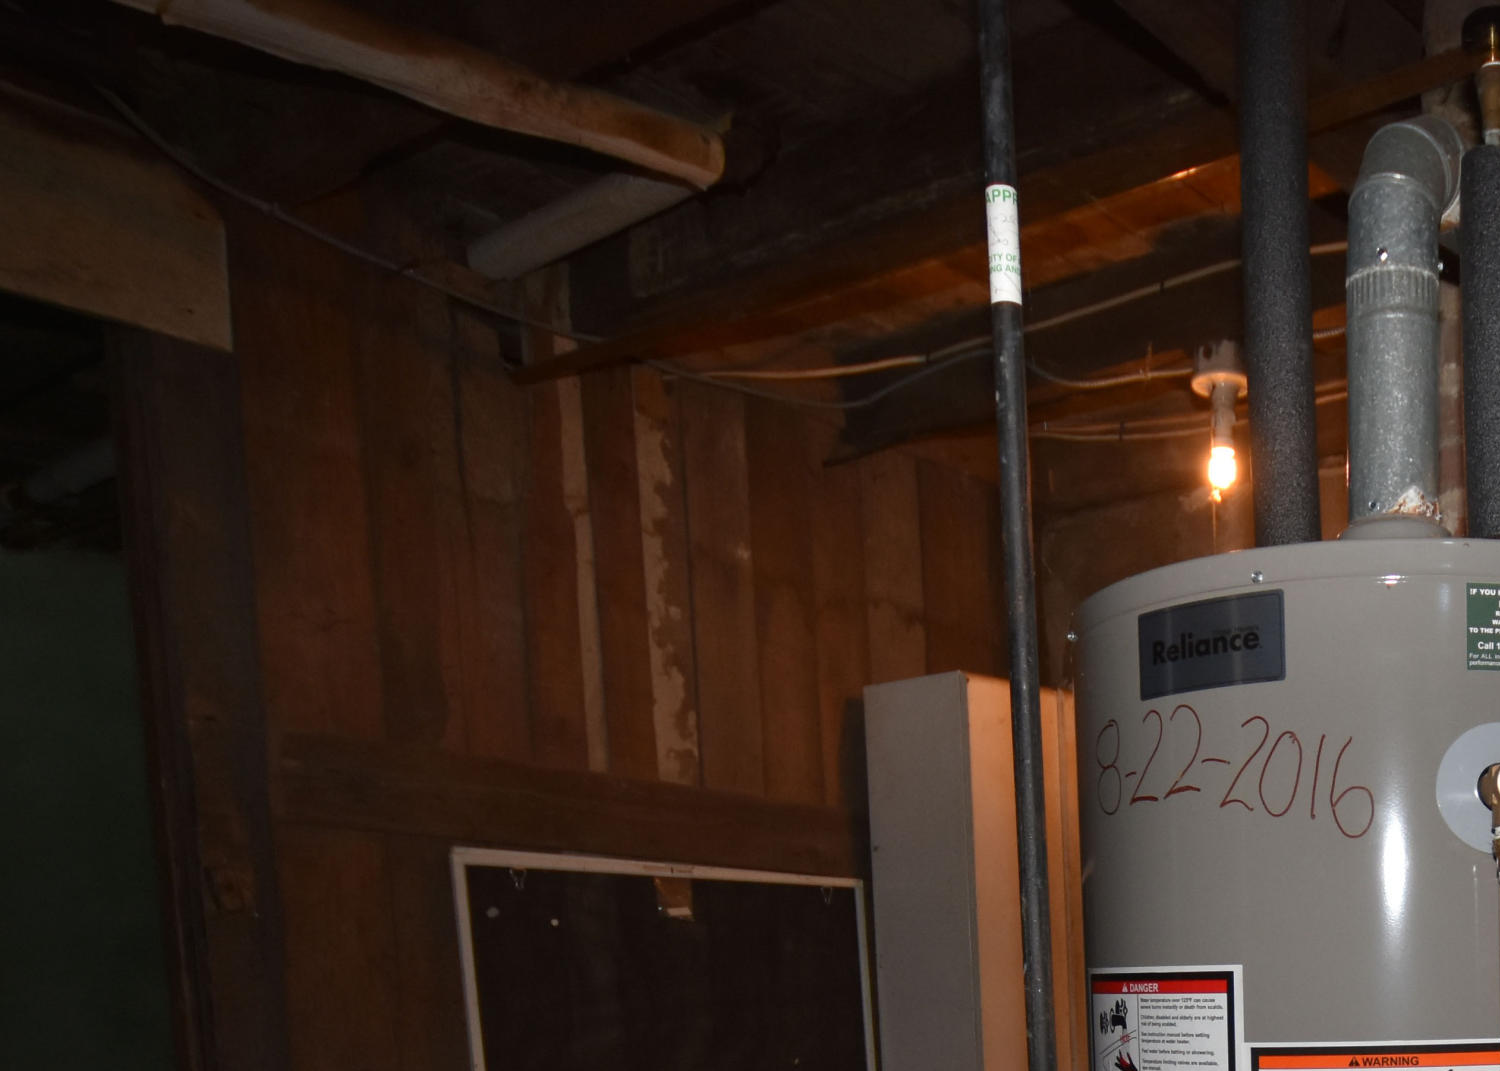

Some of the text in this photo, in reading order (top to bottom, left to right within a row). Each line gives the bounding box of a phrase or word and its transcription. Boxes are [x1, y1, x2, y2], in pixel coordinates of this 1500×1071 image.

[1480, 588, 1496, 596] YOU
[1152, 631, 1260, 666] Reliance
[1478, 641, 1494, 650] Call
[1096, 704, 1375, 838] 8-22-2016
[1130, 983, 1158, 992] DANGER
[1362, 1056, 1419, 1067] WARNING
